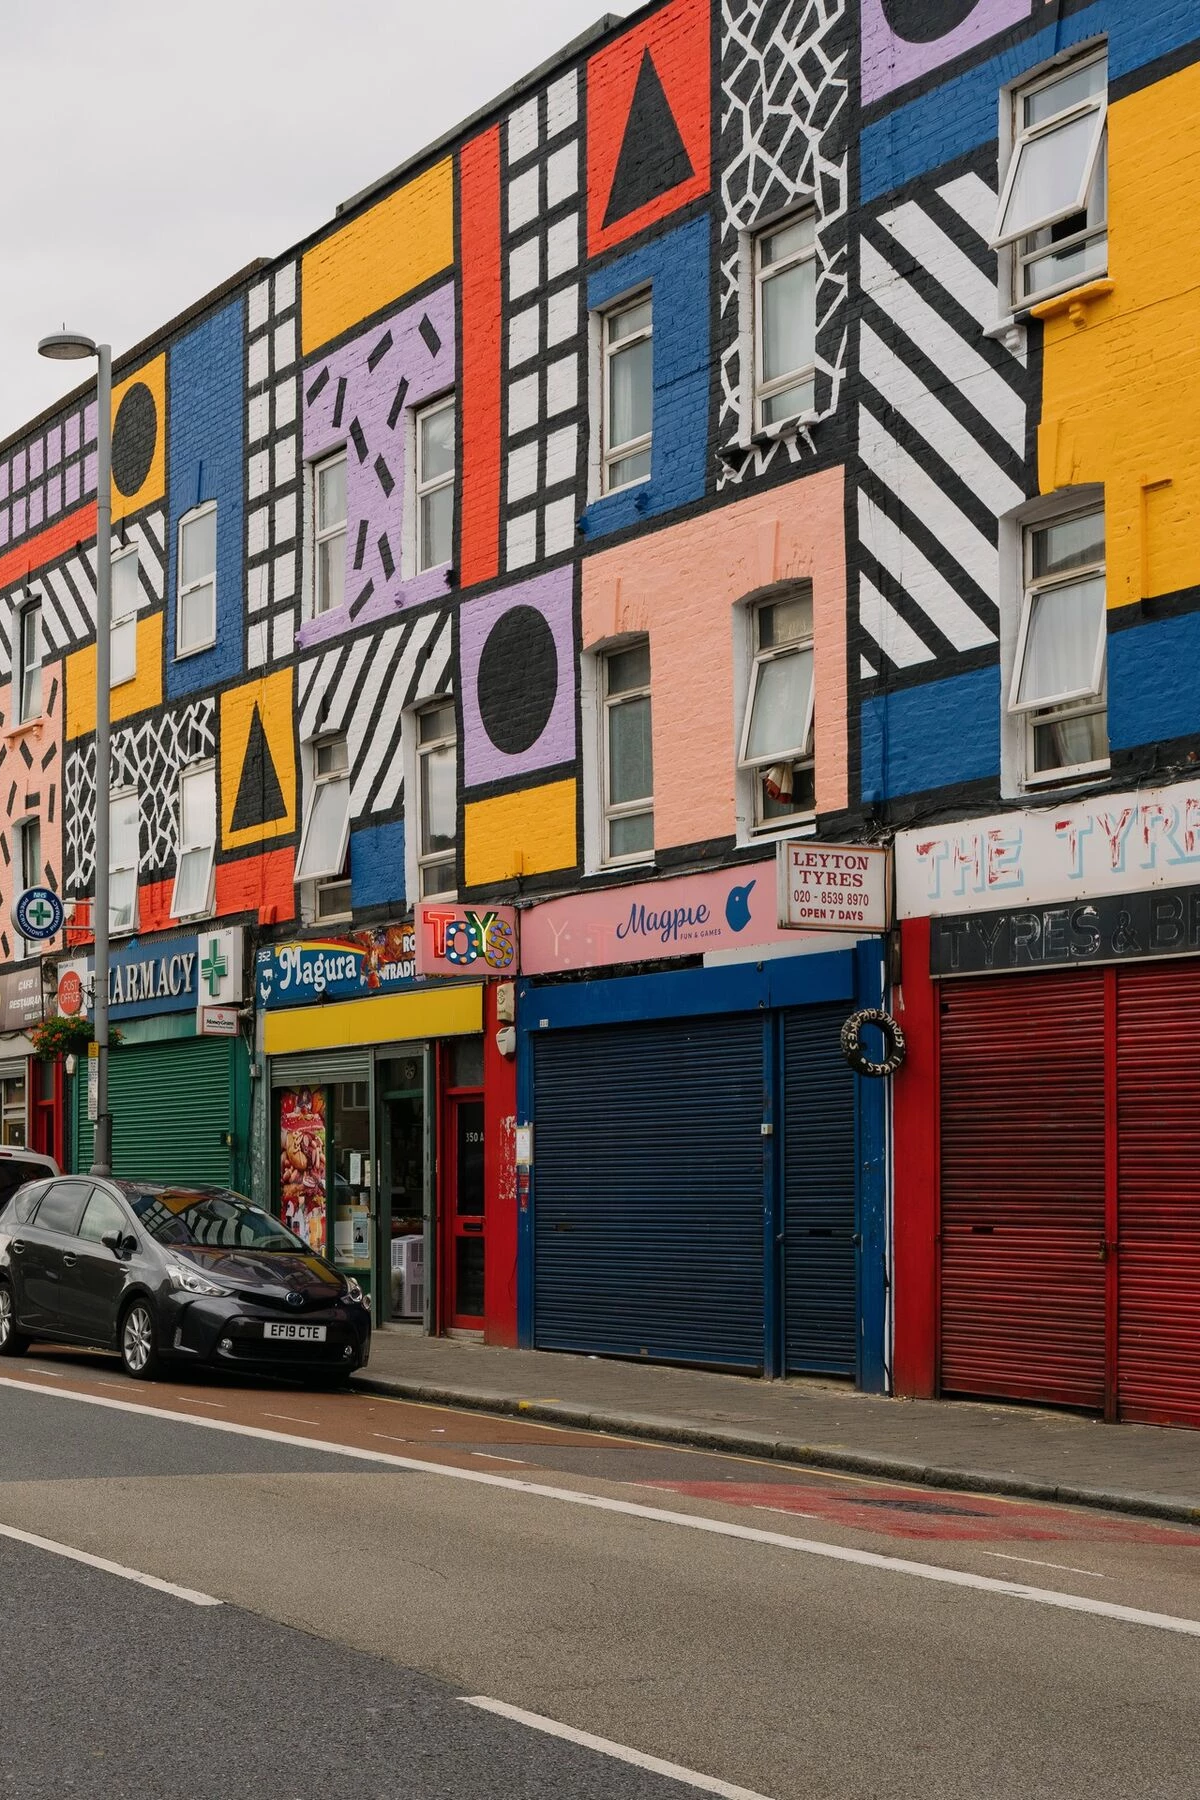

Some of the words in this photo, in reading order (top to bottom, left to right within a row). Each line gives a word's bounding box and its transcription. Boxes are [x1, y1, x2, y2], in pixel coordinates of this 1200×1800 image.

[793, 852, 869, 870] LEYTON
[916, 827, 1024, 899] THE
[799, 870, 863, 887] TYRES
[794, 890, 811, 903] 020
[821, 891, 844, 905] 8539
[847, 893, 869, 906] 8970
[20, 897, 44, 936] PRESCRIPTIONS
[50, 899, 61, 931] PHARMACY
[616, 903, 710, 943] Magpie
[800, 908, 826, 919] OPEN
[830, 910, 835, 919] 7
[838, 910, 864, 921] DAYS
[423, 910, 514, 969] TOYS
[680, 932, 693, 941] FUN
[694, 931, 698, 939] &
[700, 929, 721, 938] GAMES
[939, 905, 1101, 968] TYRES
[1111, 910, 1142, 953] &
[257, 951, 271, 963] 352
[279, 946, 357, 992] Magura
[63, 980, 78, 991] POST
[87, 953, 195, 1009] PARMACY
[60, 992, 80, 1005] OFFICE
[465, 1132, 479, 1143] 350
[270, 1324, 296, 1337] EF19
[298, 1326, 320, 1339] CTE
